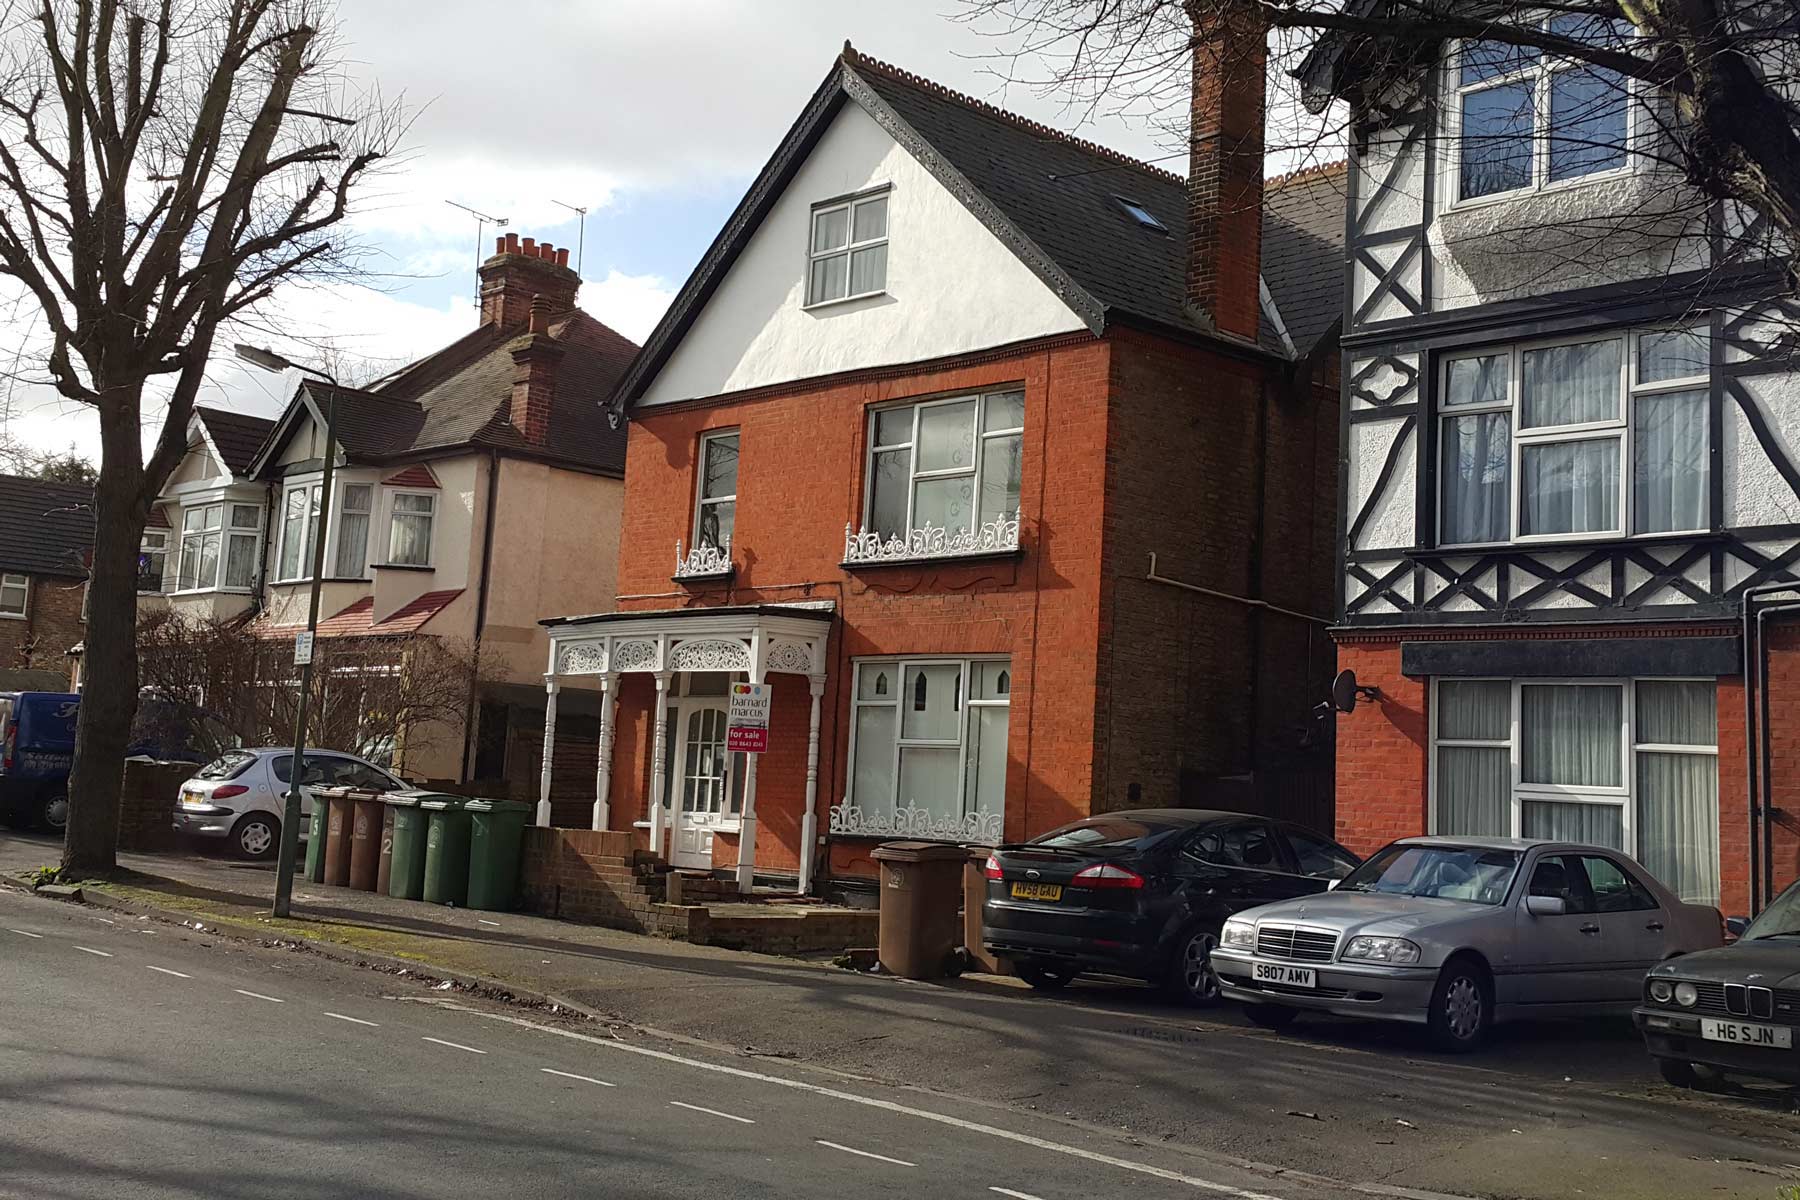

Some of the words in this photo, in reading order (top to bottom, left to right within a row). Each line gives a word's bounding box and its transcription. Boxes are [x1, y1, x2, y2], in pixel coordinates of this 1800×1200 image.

[732, 695, 768, 708] barnard
[731, 707, 764, 718] marcus
[730, 729, 744, 738] for
[744, 730, 760, 739] sale
[382, 838, 393, 855] 2
[1015, 881, 1039, 896] HV58
[1257, 964, 1285, 981] S807
[1287, 968, 1311, 985] AMV
[1717, 1022, 1738, 1041] H6
[1741, 1025, 1775, 1045] SJN
